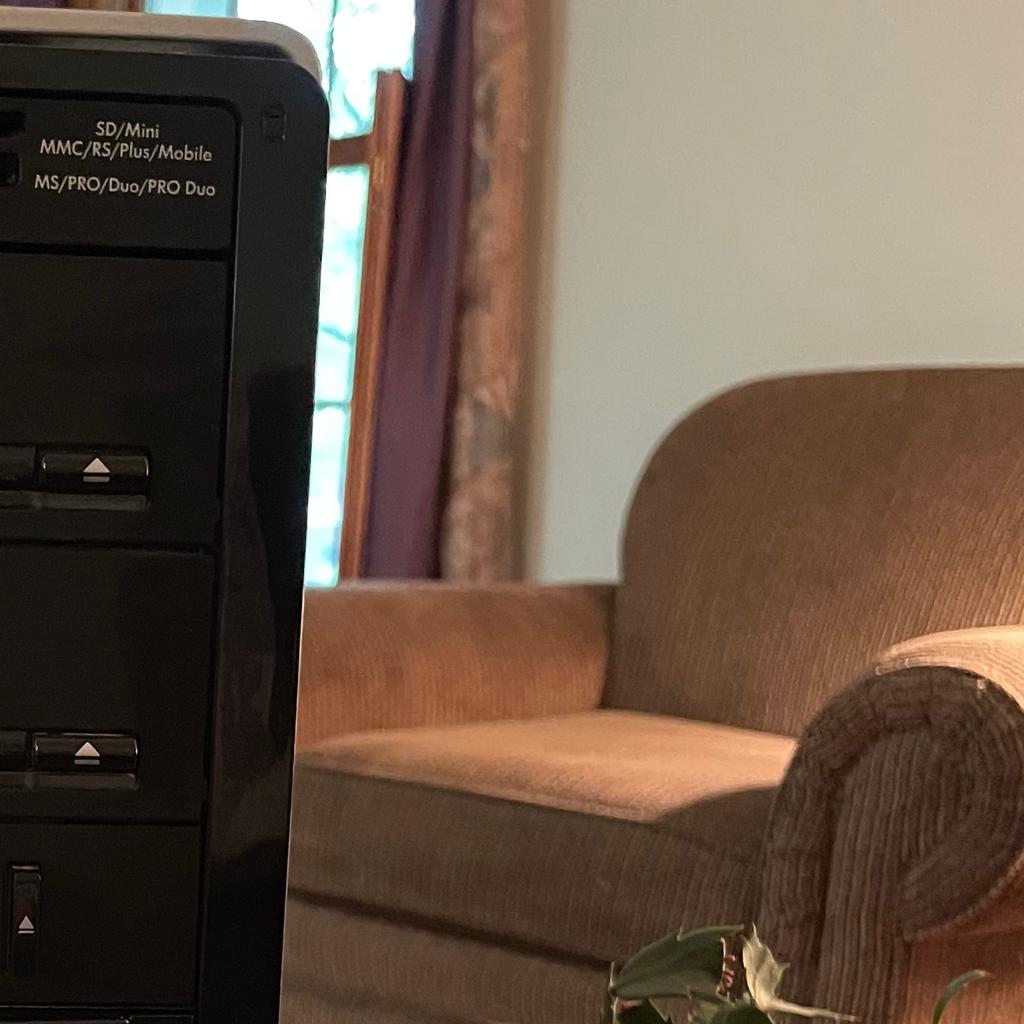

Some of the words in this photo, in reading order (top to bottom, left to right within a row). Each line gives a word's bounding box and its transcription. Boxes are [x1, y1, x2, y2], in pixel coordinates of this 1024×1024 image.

[95, 120, 160, 140] SD/Mini
[39, 139, 213, 163] MMC/RS/Plus/Mobile
[34, 174, 181, 197] MS/PRO/Duo/PRO
[185, 180, 216, 197] Duo
